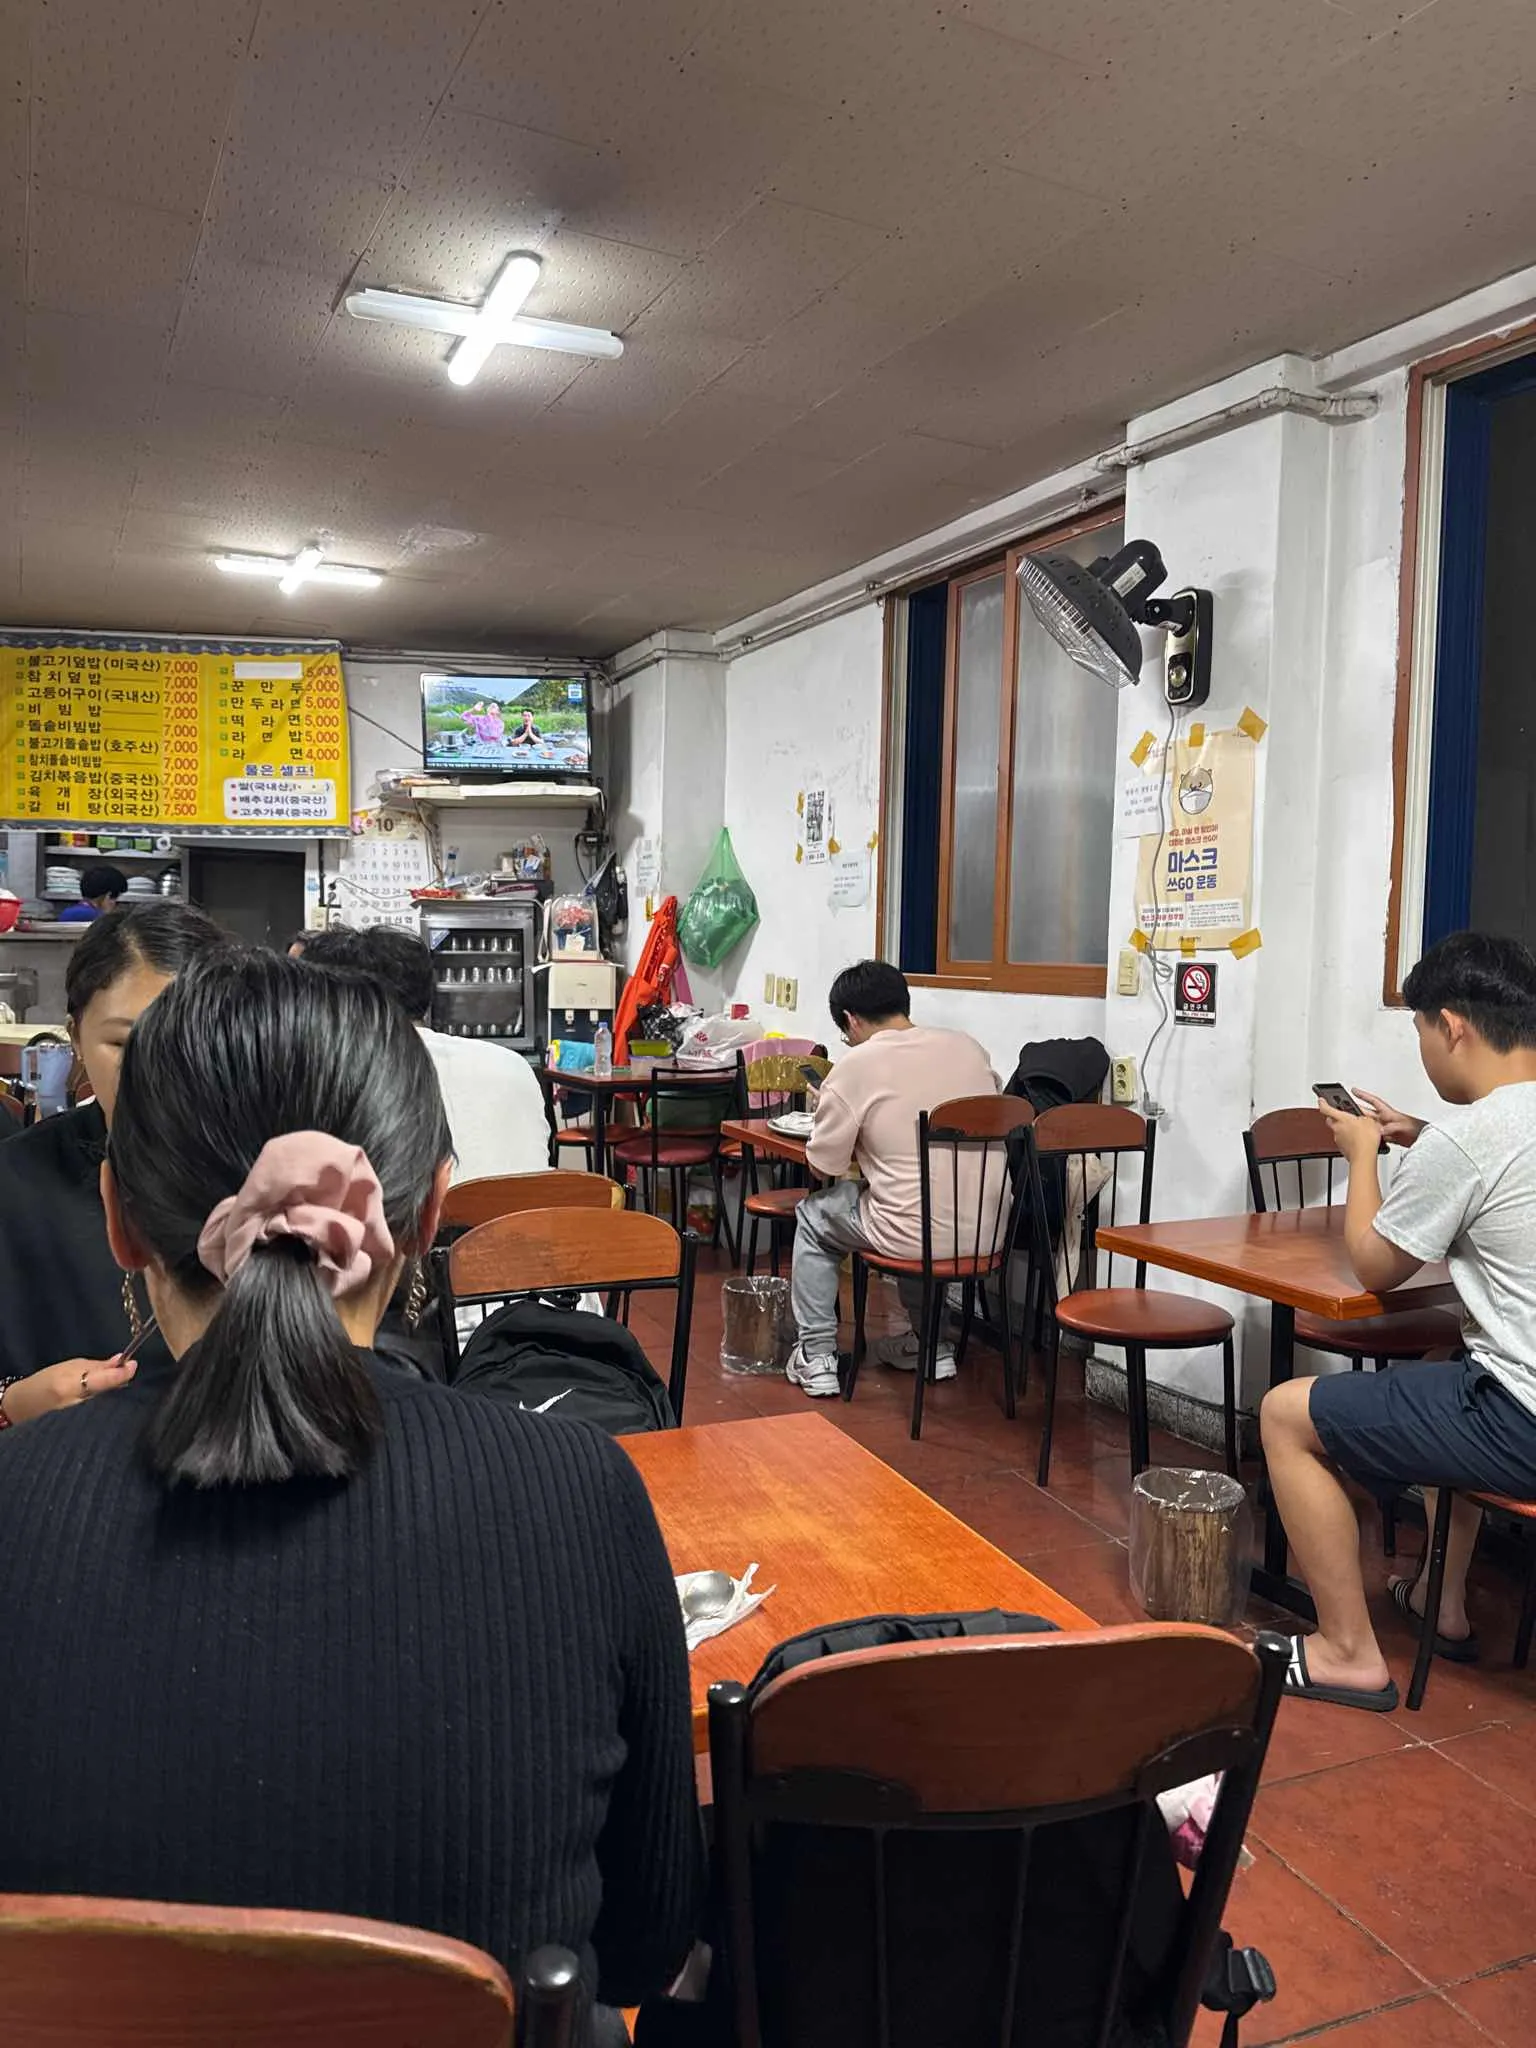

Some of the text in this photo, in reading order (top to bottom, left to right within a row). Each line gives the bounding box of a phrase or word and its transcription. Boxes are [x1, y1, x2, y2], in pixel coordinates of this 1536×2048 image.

[376, 817, 394, 832] 10
[1168, 848, 1218, 873] 마스크
[1167, 874, 1217, 892] 쓰GO 운동
